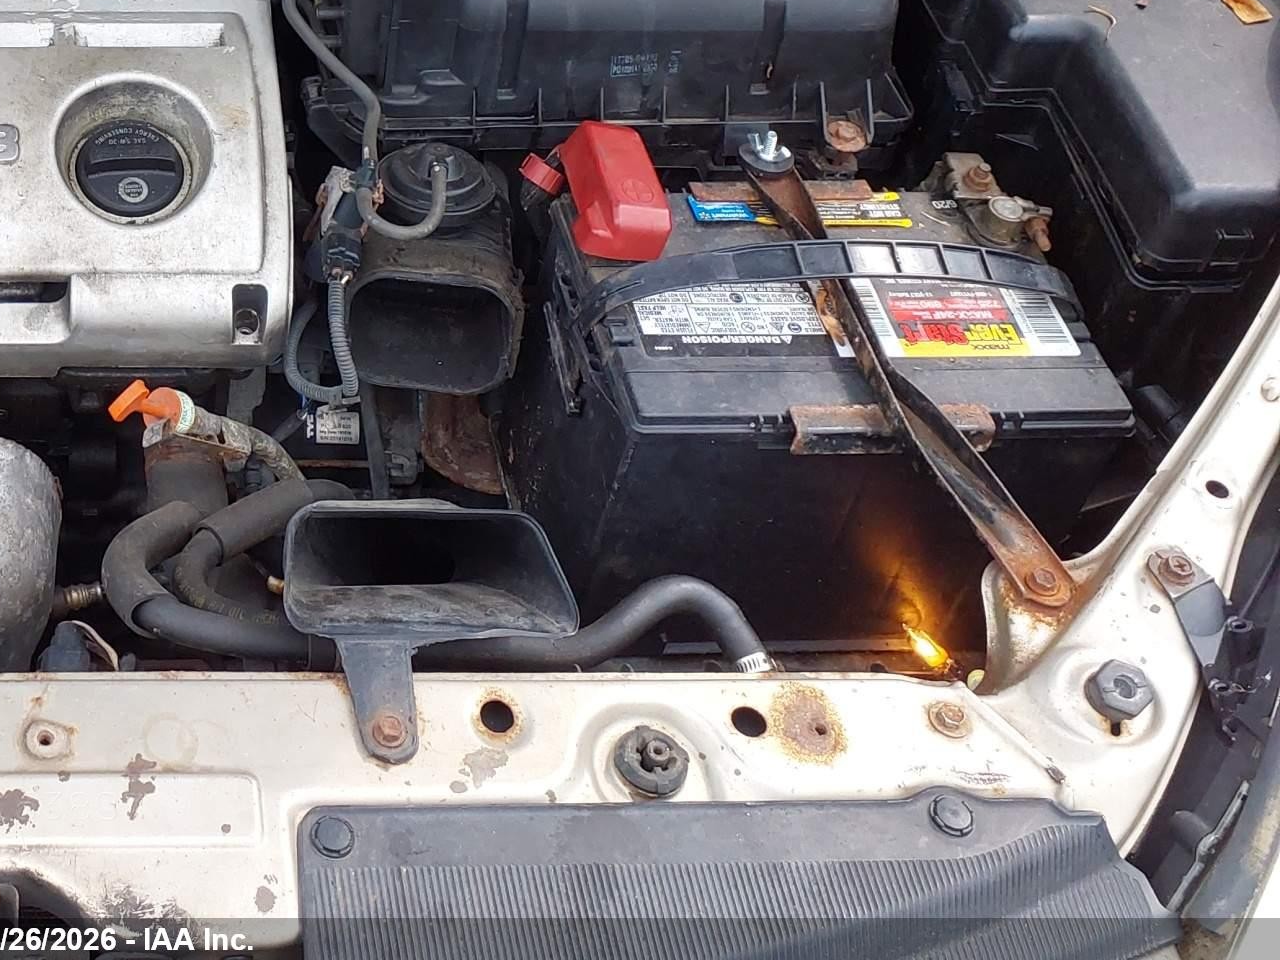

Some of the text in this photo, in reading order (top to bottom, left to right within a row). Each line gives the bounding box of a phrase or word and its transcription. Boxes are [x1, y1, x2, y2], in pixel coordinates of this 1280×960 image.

[932, 199, 958, 209] 6/20
[902, 323, 1023, 345] EverStart
[681, 335, 782, 344] DANGER/POISON
